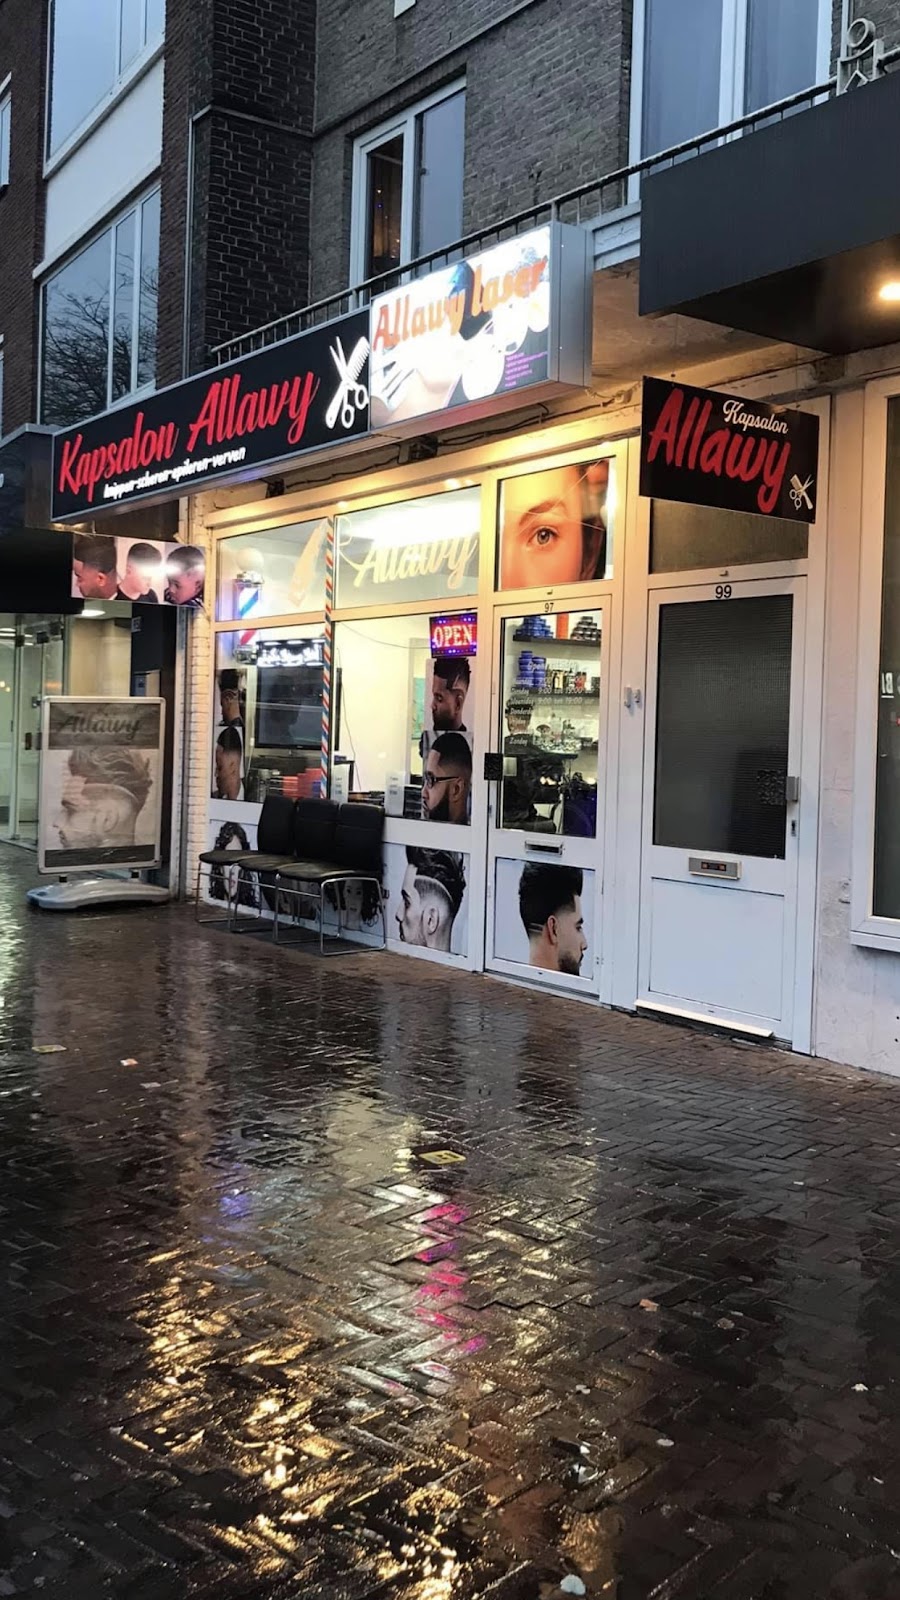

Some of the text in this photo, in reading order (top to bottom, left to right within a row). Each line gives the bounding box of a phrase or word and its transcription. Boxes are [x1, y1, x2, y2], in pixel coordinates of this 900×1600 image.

[372, 255, 549, 352] Allawy laser
[722, 399, 789, 434] Kapsalon
[59, 371, 321, 503] Kapsalon Allawy
[646, 387, 792, 514] Allawy
[347, 527, 478, 590] Allawy
[544, 602, 554, 613] 97
[714, 584, 732, 600] 99
[433, 623, 474, 648] OPEN
[55, 710, 141, 741] Allawy
